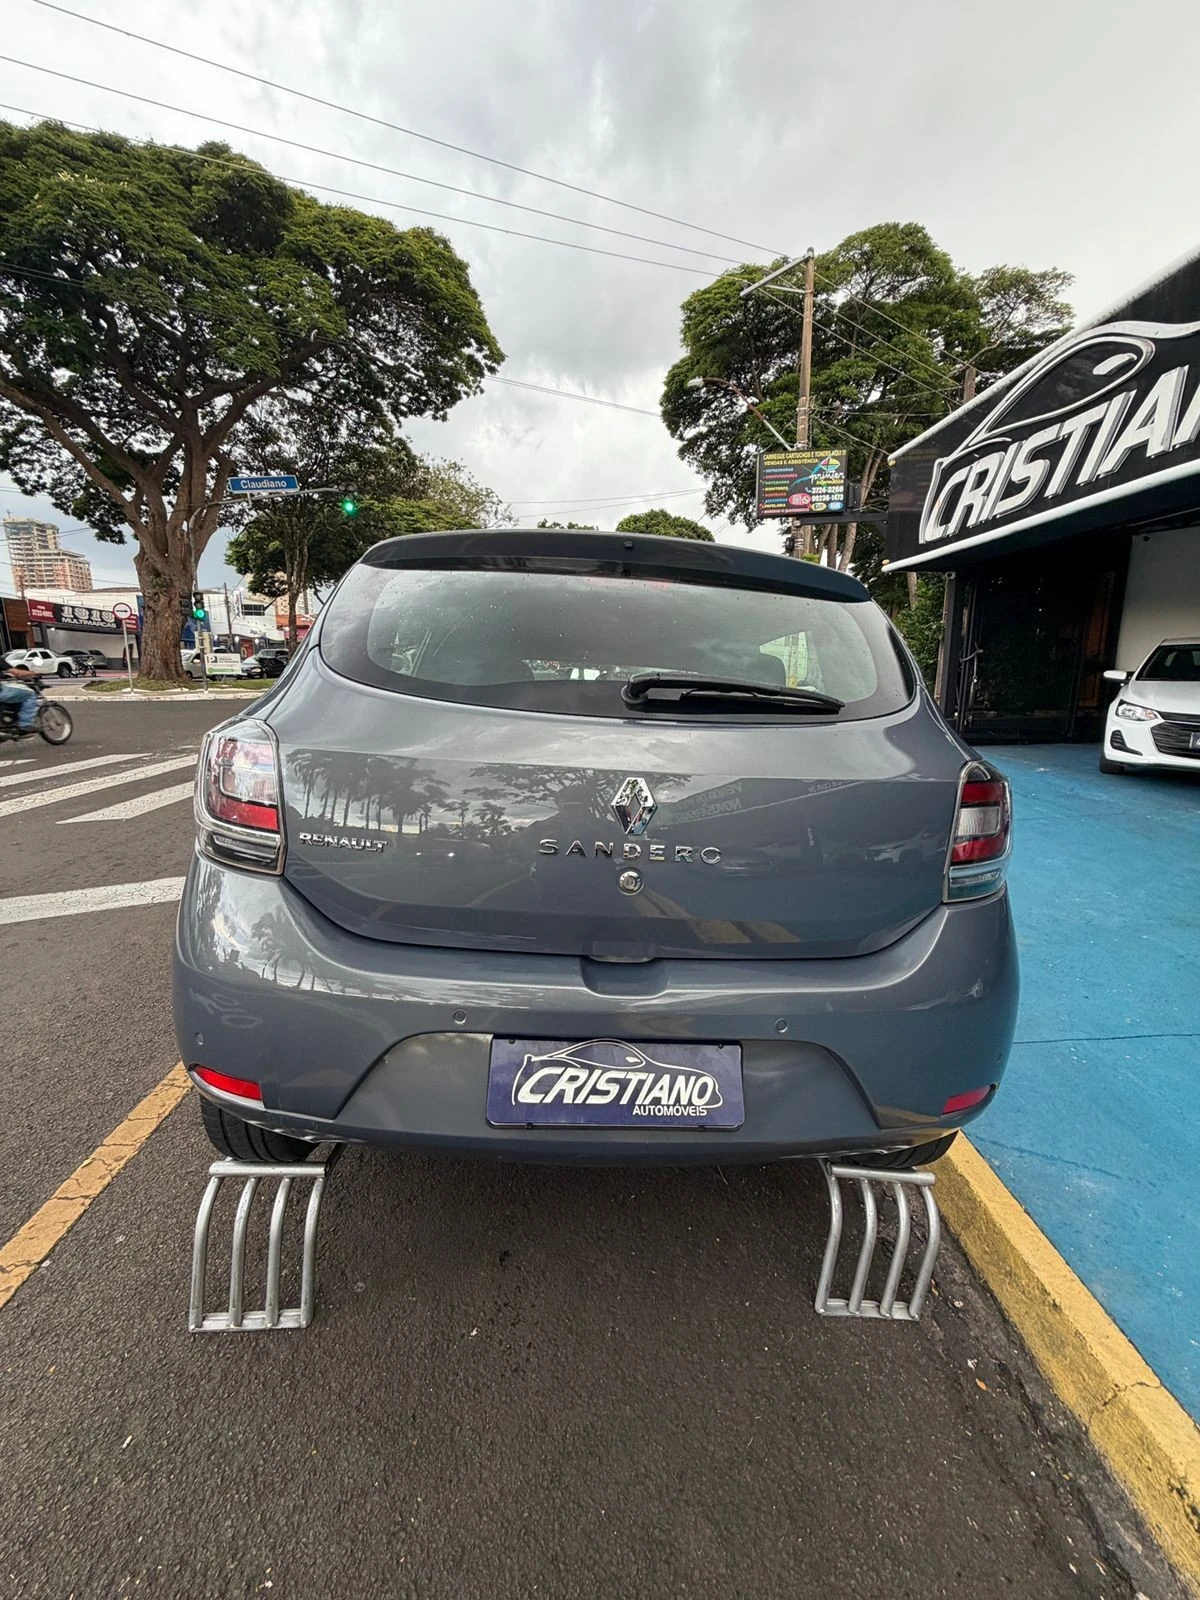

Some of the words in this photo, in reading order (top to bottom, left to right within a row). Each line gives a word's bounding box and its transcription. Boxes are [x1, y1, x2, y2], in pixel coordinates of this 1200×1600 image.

[240, 479, 287, 489] Claudiano
[61, 617, 117, 628] MULTIMARCAS
[299, 832, 388, 853] RENAULT
[538, 838, 722, 864] SANDERO
[517, 1066, 714, 1105] CRISTIANO
[632, 1103, 708, 1117] AUTOMÓVEIS
